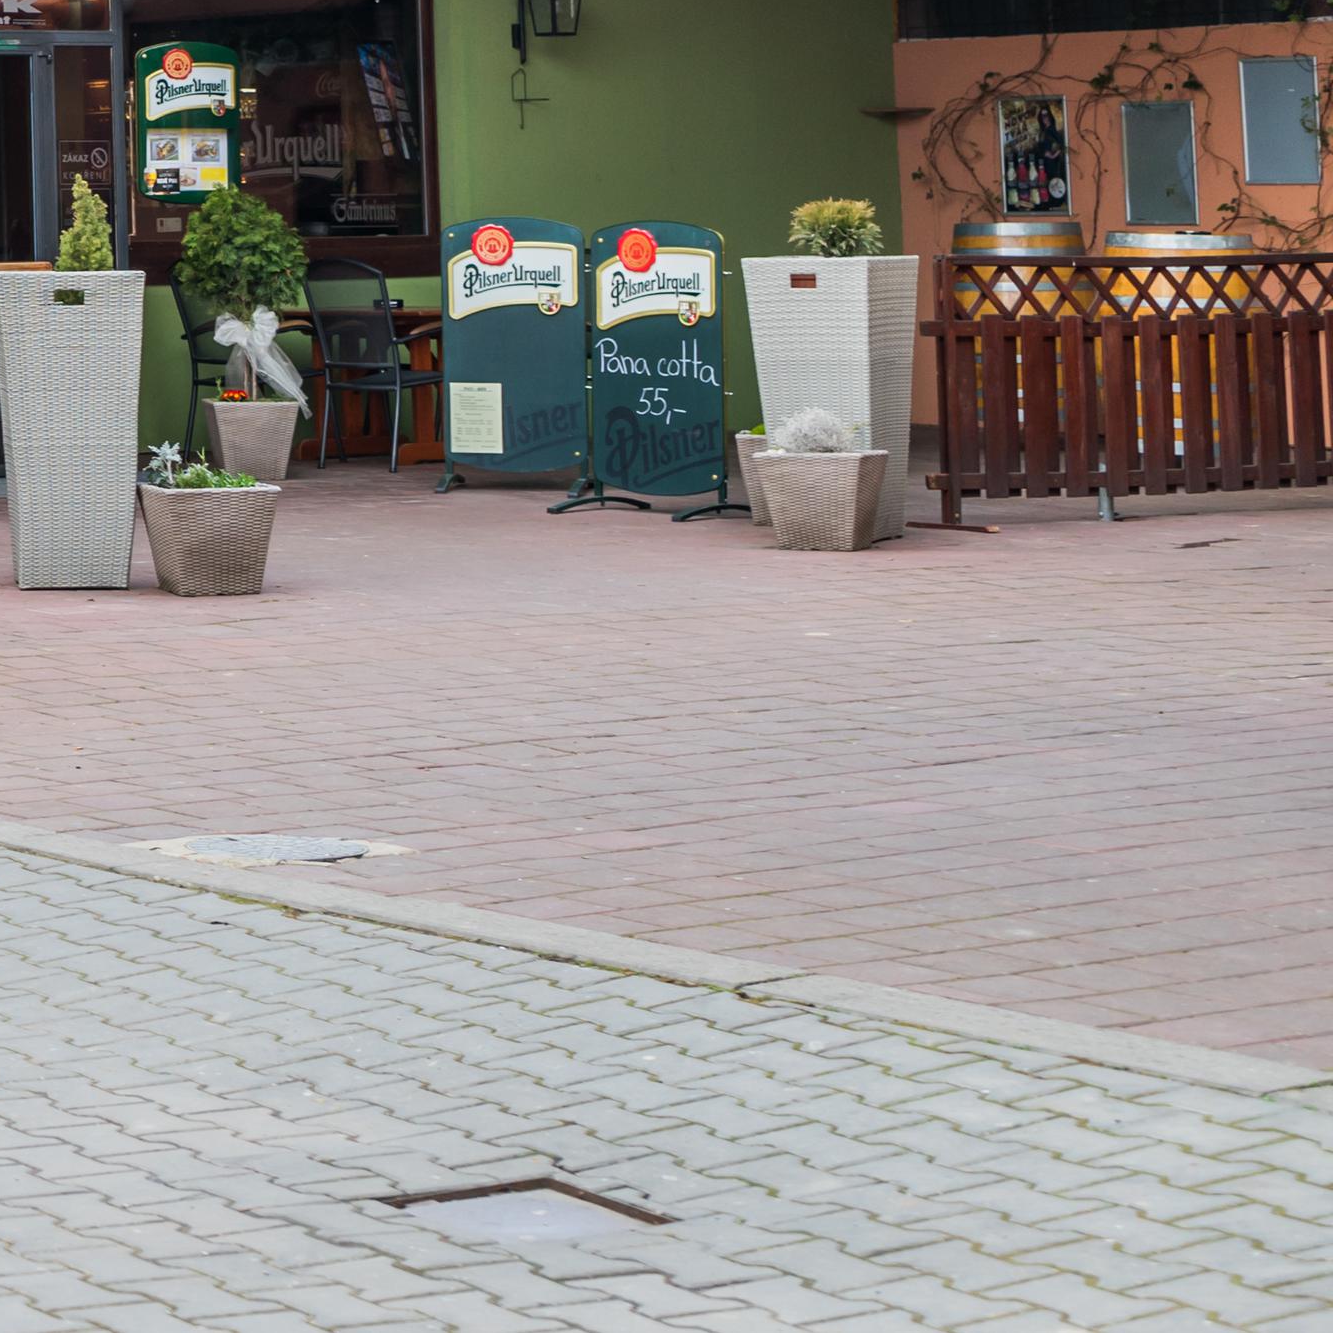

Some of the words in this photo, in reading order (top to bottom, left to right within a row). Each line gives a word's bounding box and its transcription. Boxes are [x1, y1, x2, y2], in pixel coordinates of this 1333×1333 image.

[155, 79, 194, 105] Pilsner
[193, 78, 227, 97] Urquell
[61, 152, 90, 163] ZÁKAZ
[250, 120, 341, 181] Urquell
[62, 169, 107, 181] KOŘENÍ
[463, 263, 513, 298] Pilsner
[512, 263, 562, 288] Urquell
[610, 271, 657, 307] Pilsner
[656, 271, 701, 297] Urquell
[595, 337, 652, 376] Pana
[656, 338, 721, 387] cotta
[636, 387, 687, 425] 55,-
